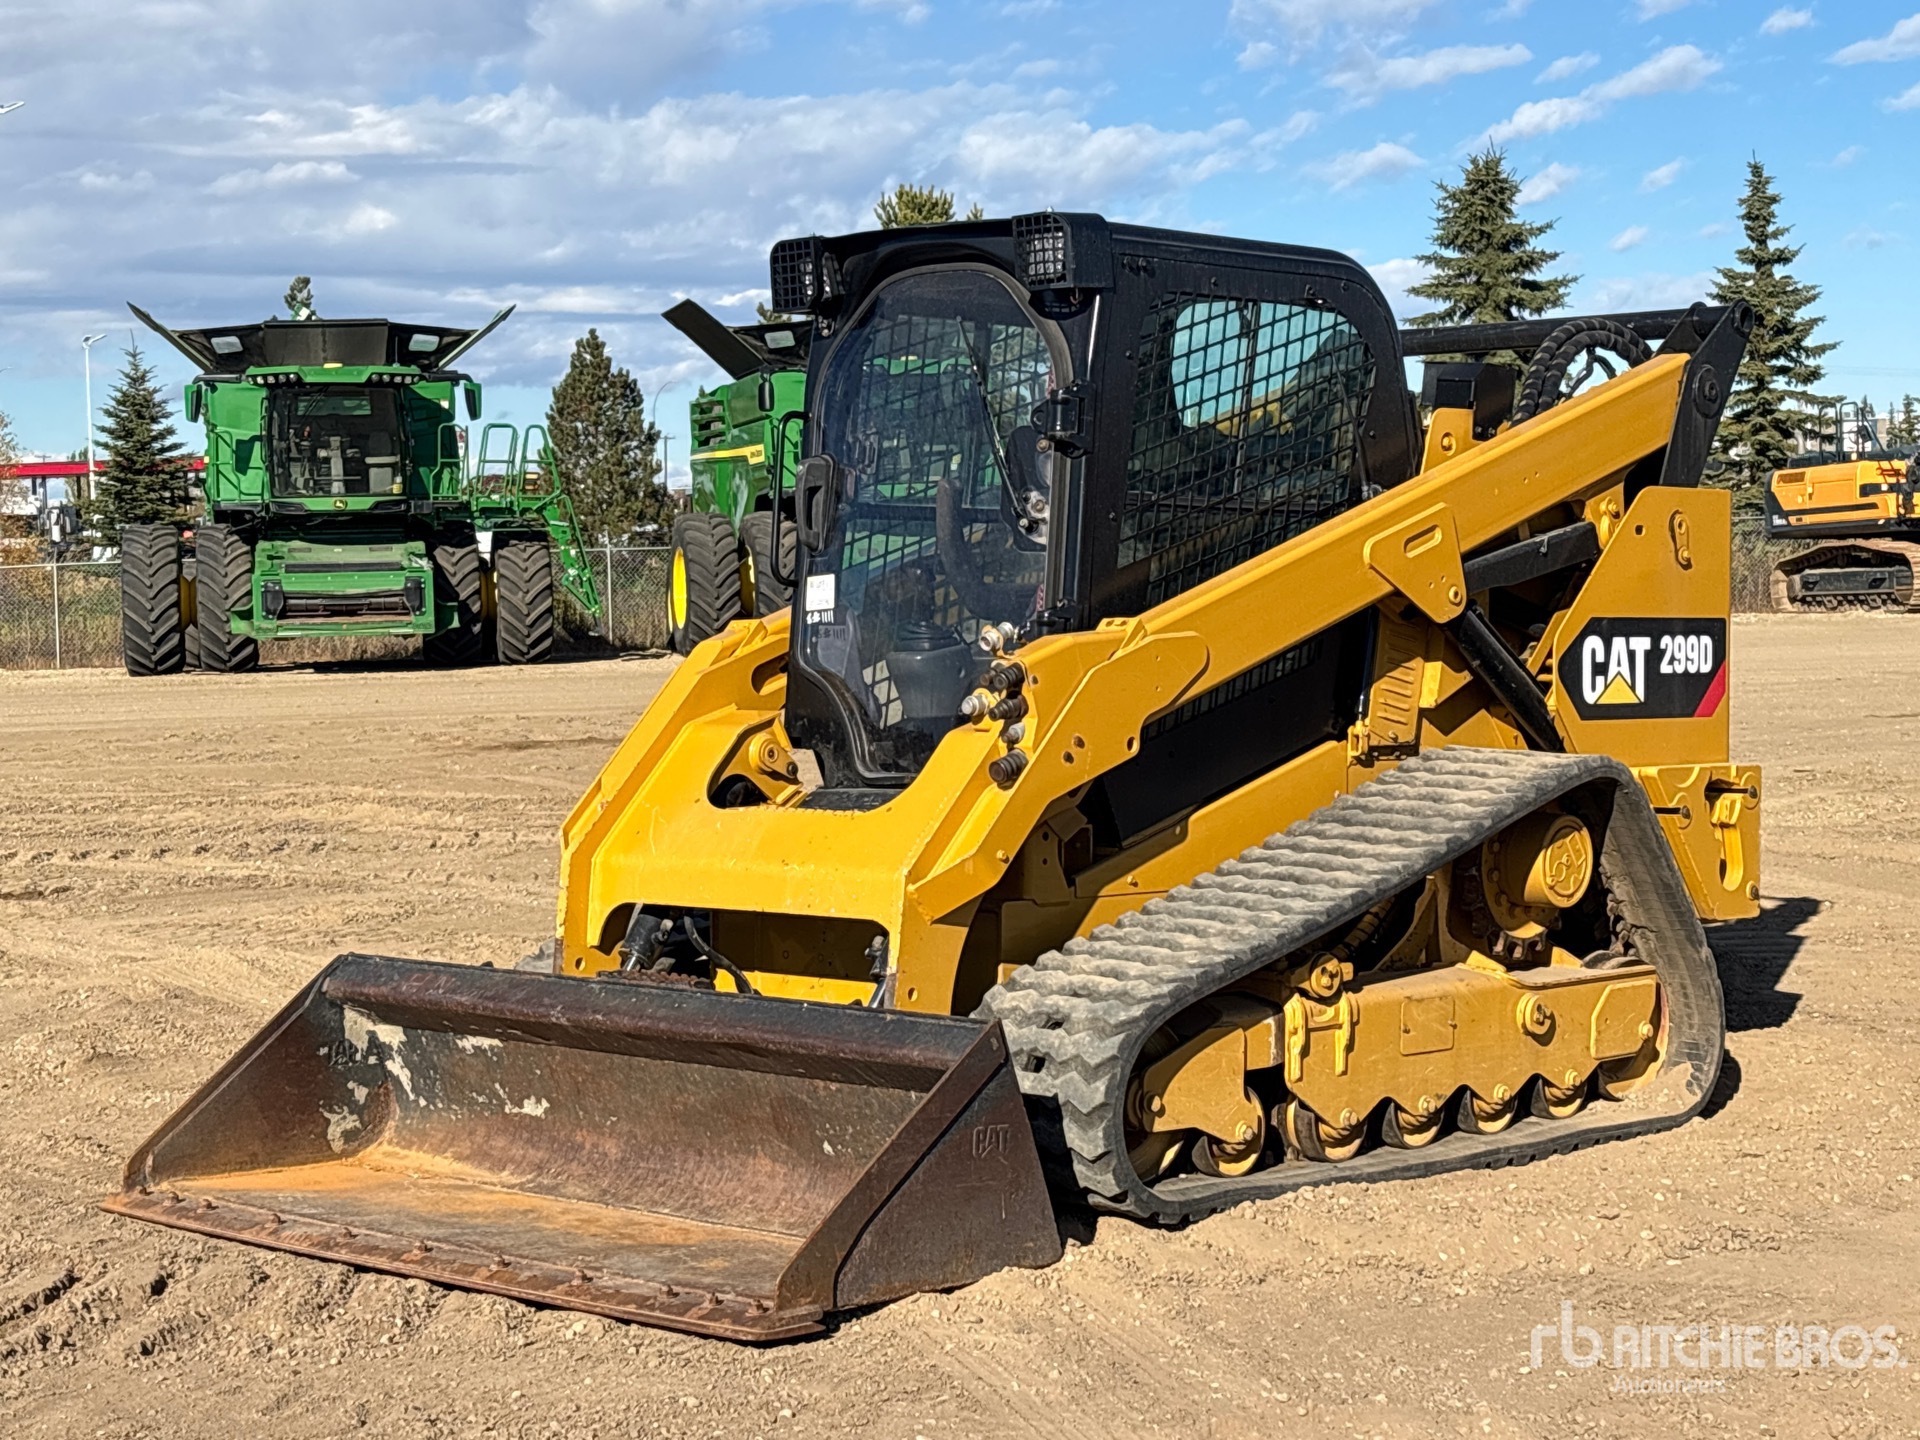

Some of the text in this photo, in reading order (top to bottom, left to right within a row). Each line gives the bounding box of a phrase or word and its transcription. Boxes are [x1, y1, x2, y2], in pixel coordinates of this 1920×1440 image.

[1582, 634, 1713, 705] CAT 299D
[972, 1123, 1010, 1159] CAT
